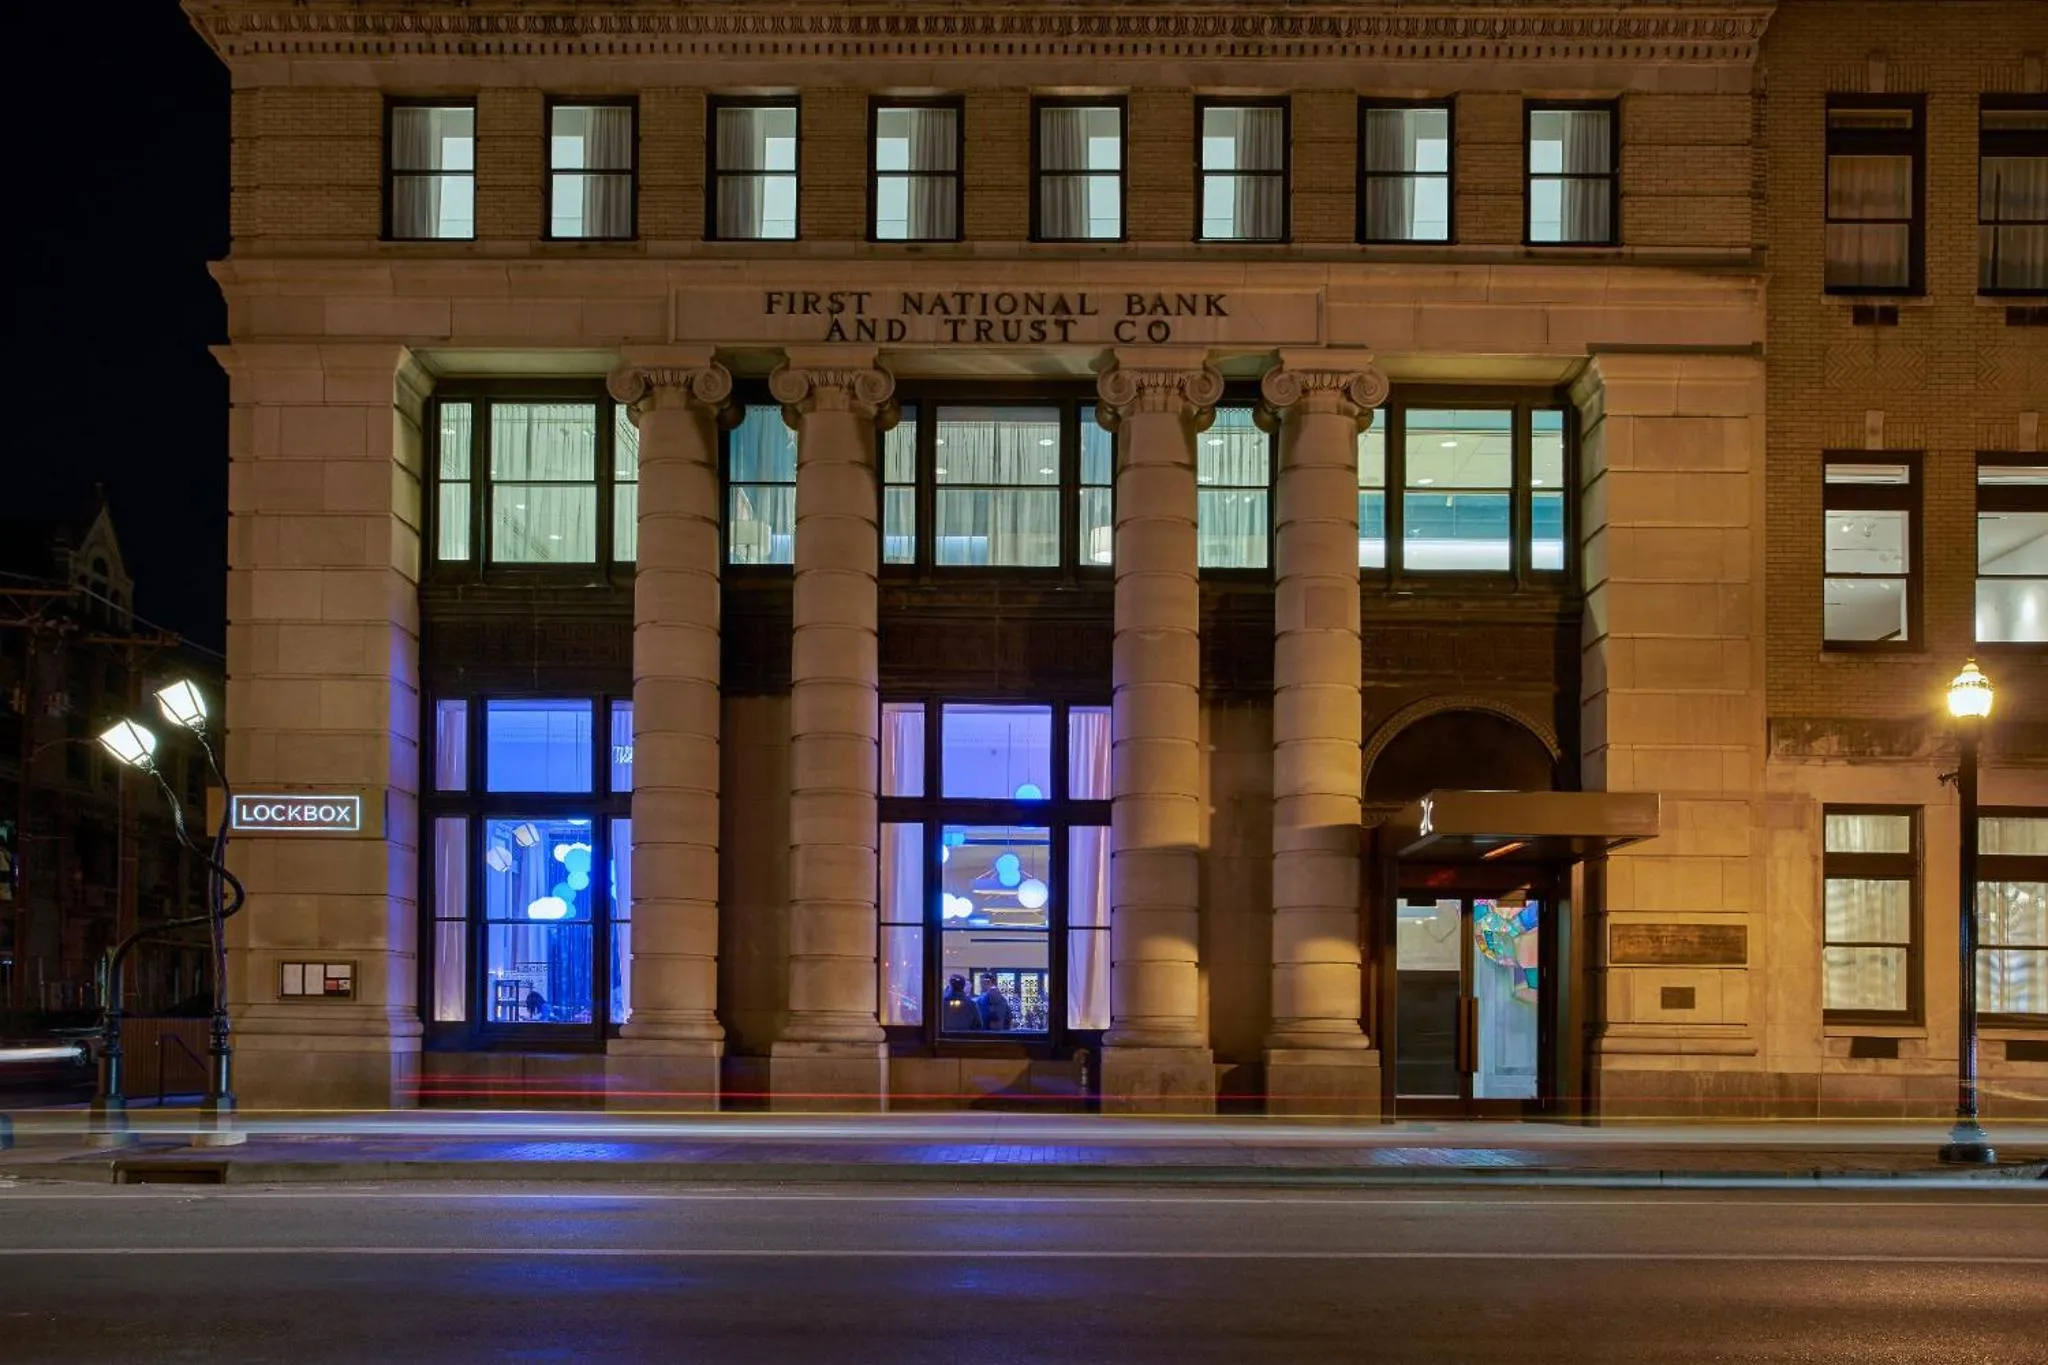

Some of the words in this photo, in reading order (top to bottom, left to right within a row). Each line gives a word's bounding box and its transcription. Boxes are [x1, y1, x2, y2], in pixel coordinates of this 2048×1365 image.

[765, 291, 872, 315] FIRST
[901, 292, 1098, 316] NATIONAL
[1125, 292, 1229, 316] BANK
[824, 318, 907, 342] AND
[944, 319, 1077, 342] TRUST
[1114, 320, 1170, 343] CO
[242, 804, 351, 822] LOCKBOX
